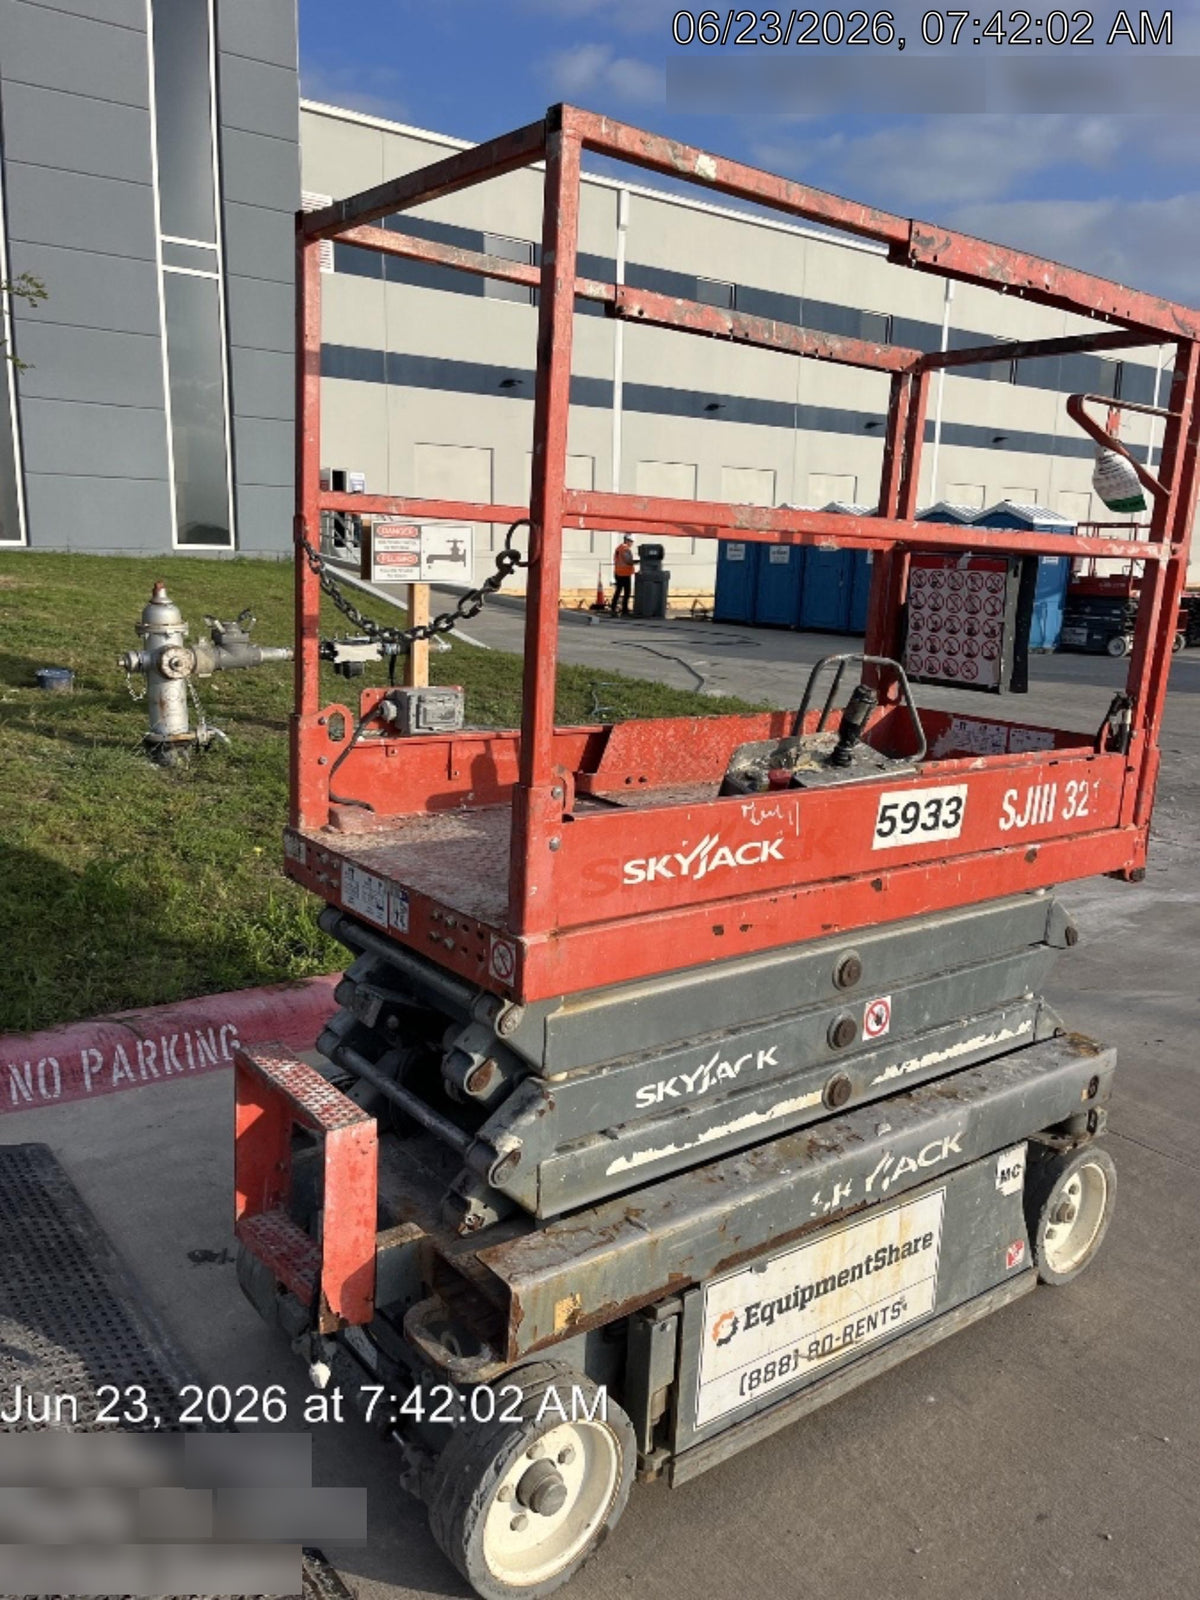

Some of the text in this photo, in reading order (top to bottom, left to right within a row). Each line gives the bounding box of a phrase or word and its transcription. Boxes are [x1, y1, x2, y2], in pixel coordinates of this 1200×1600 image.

[876, 796, 963, 838] 5933
[623, 833, 784, 885] SKYJACK
[8, 1023, 241, 1105] NO PARKING
[743, 1231, 933, 1331] EquipmentShare
